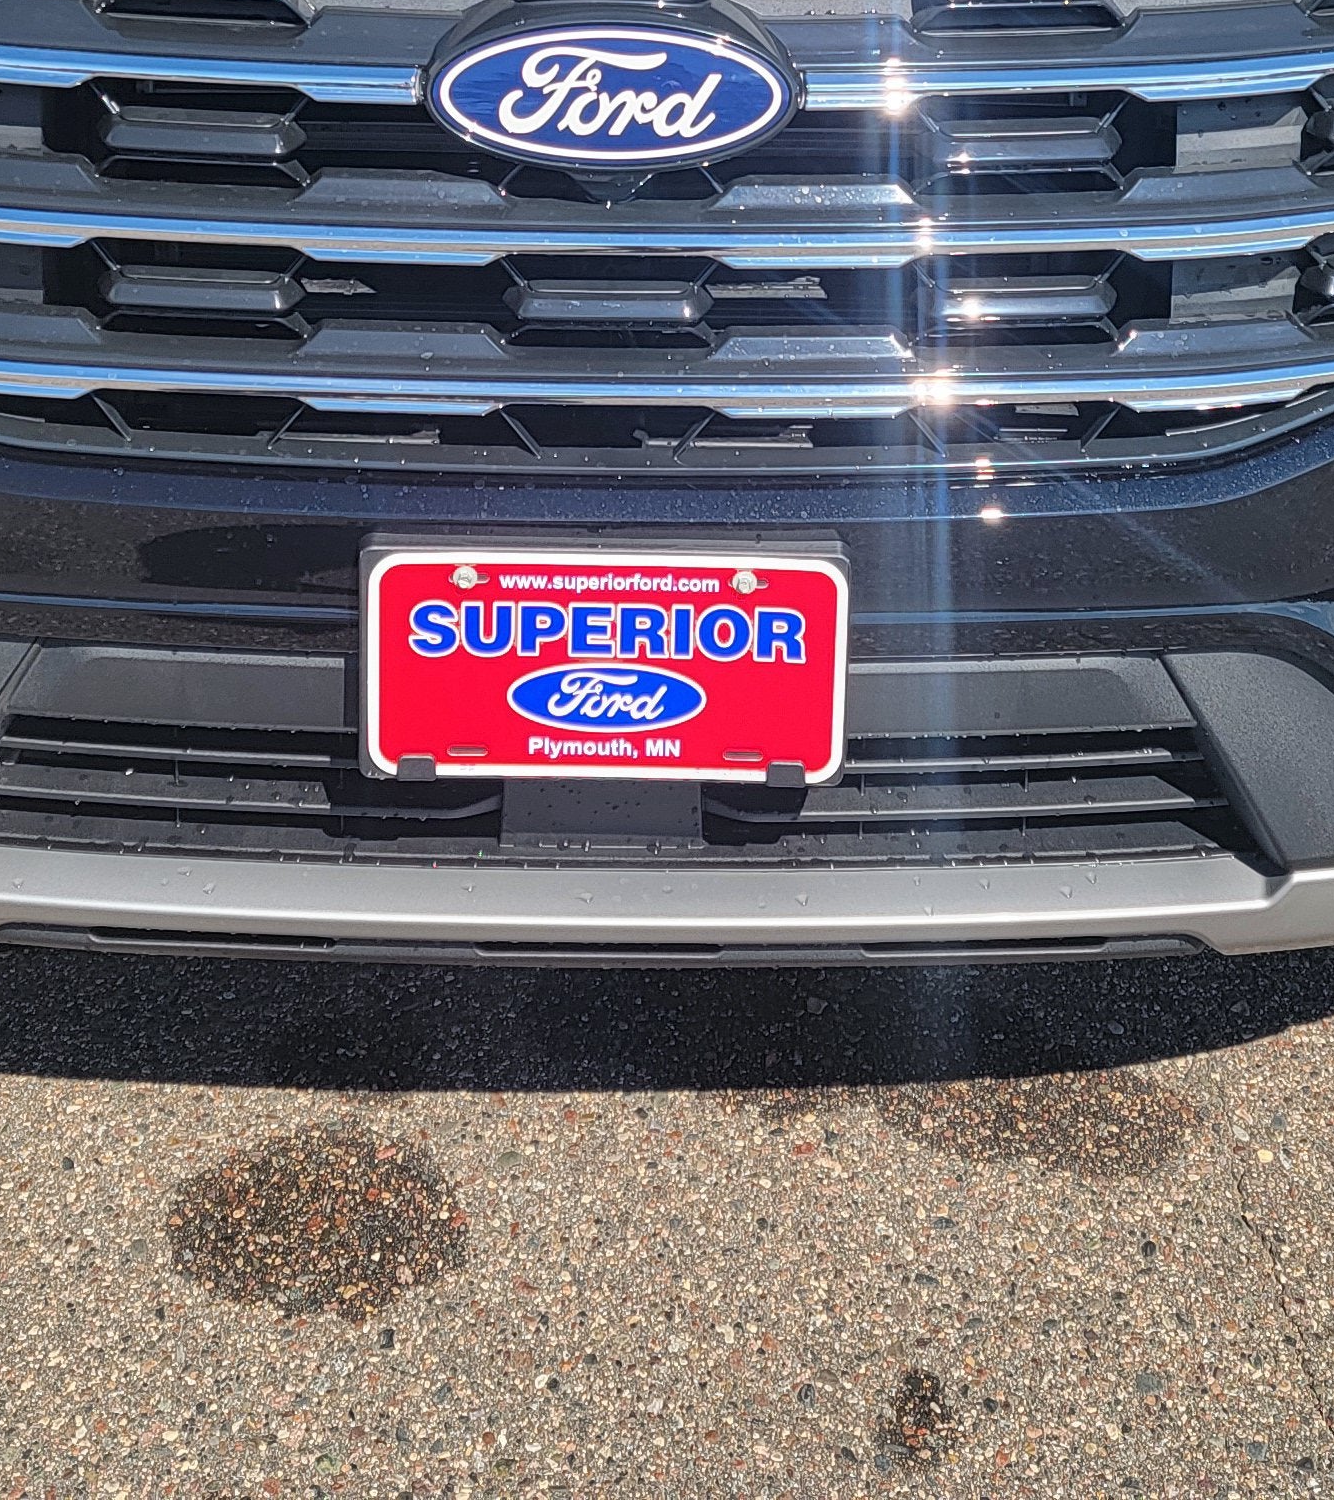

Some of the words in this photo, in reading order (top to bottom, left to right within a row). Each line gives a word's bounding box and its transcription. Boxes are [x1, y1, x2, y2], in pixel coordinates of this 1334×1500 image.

[498, 47, 722, 138] Ford
[499, 573, 720, 594] www.superiorford.com
[408, 601, 806, 664] SUPERIOR
[547, 672, 668, 720] Ford
[528, 737, 639, 759] Plymouth,
[645, 739, 681, 758] MN
